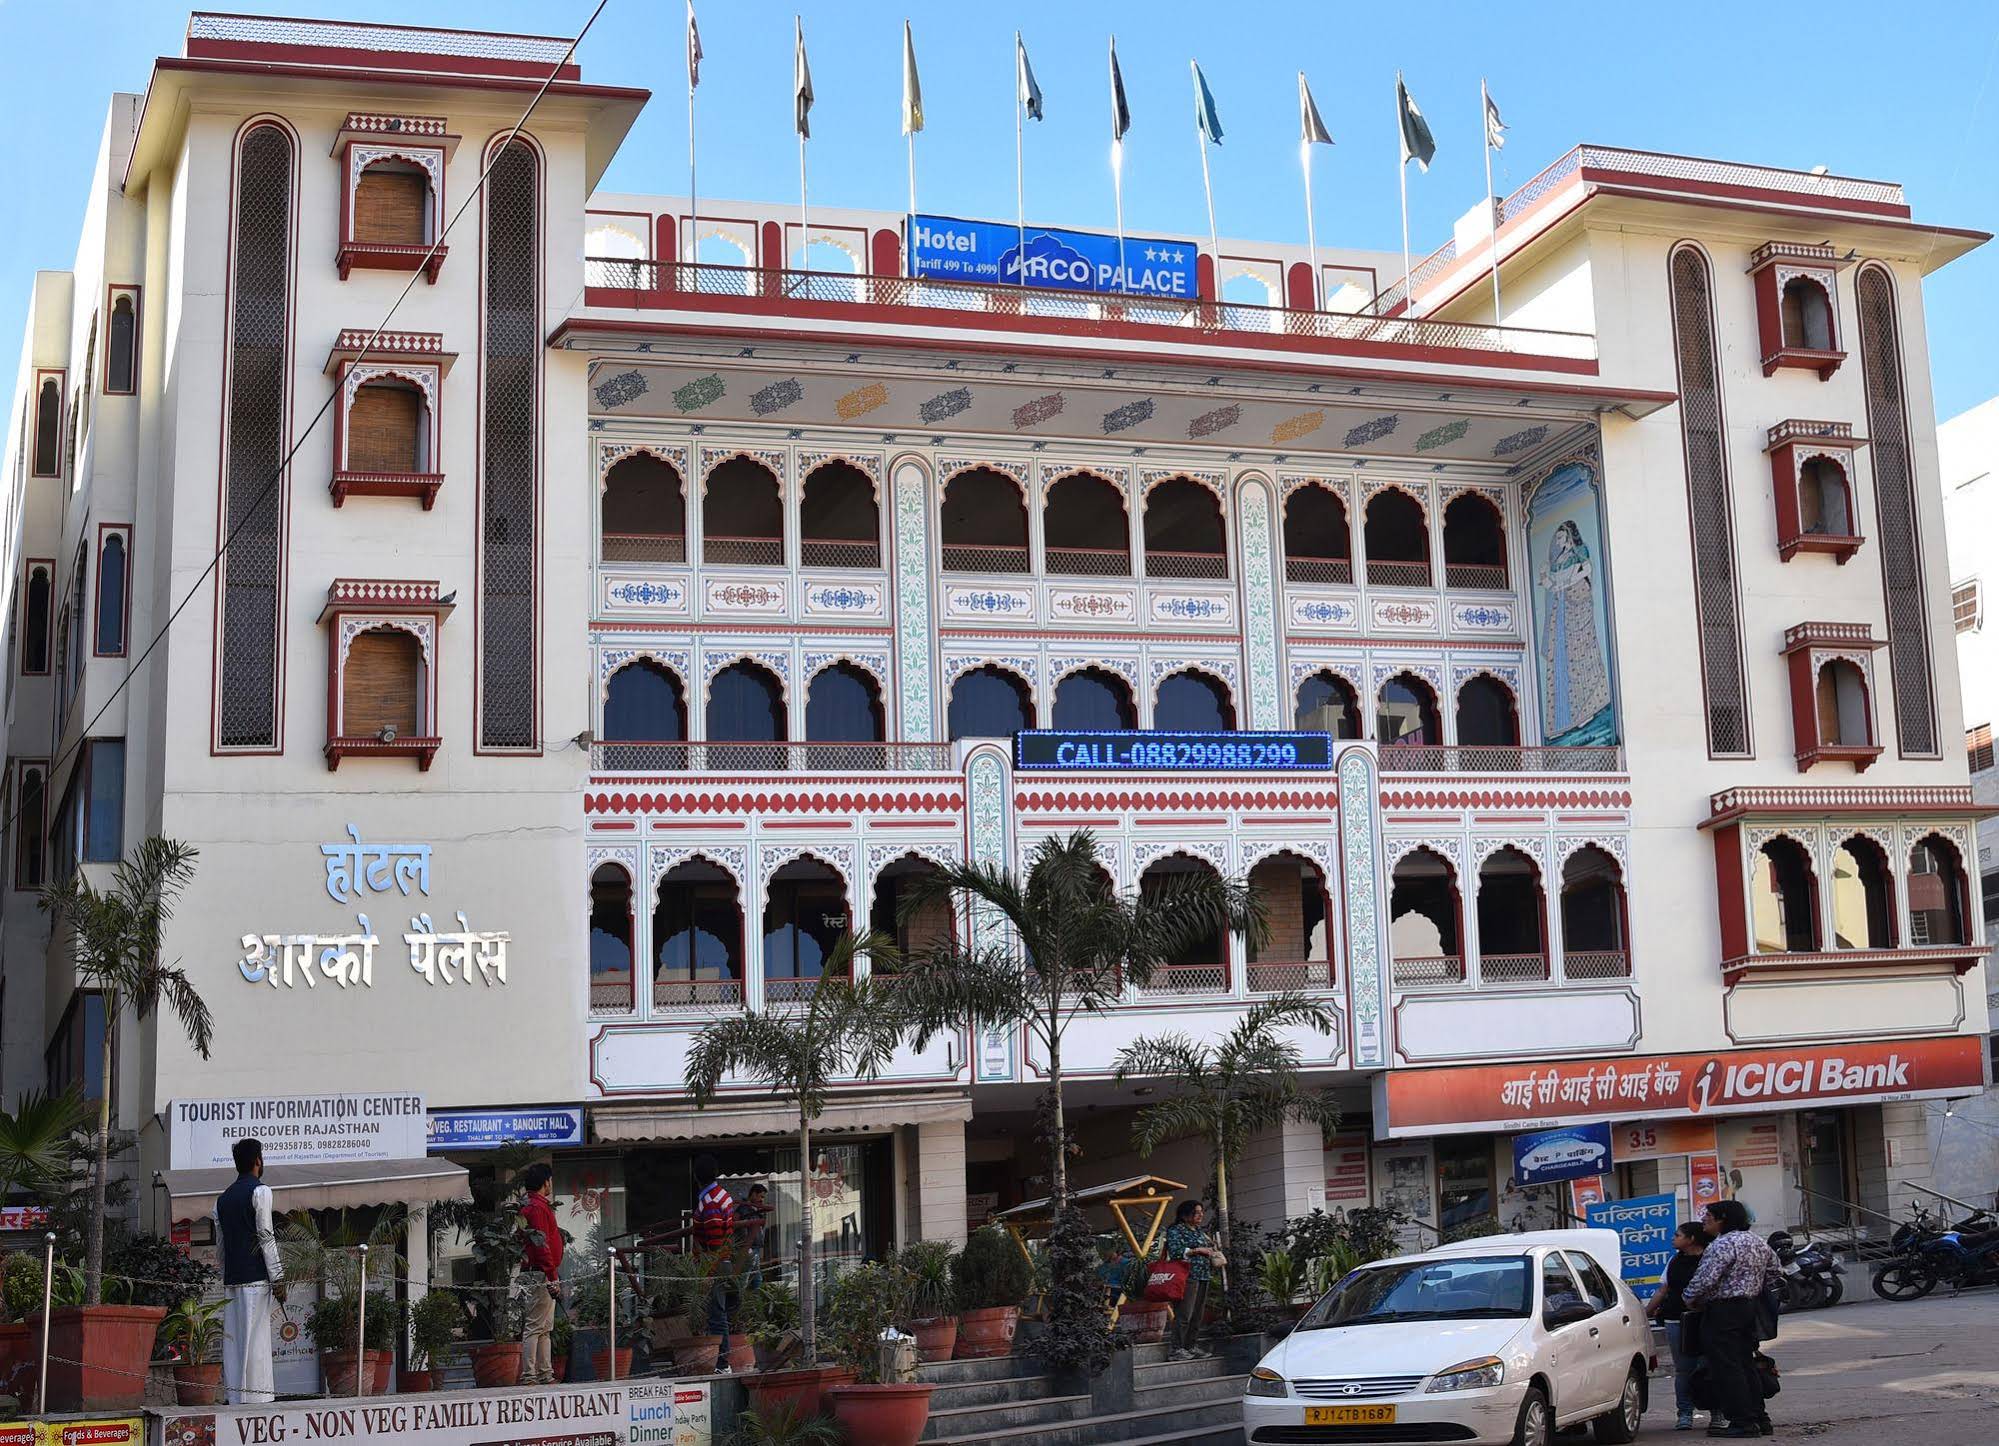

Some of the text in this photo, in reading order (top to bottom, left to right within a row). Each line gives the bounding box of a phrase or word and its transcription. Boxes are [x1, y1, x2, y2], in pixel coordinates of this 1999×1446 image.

[915, 225, 976, 252] Hotel
[916, 256, 997, 276] Tariff 499 To 4999
[1007, 255, 1186, 294] ARCO PALACE
[320, 823, 433, 904] होटल
[239, 910, 512, 989] आरको पैलेस
[1501, 1061, 1682, 1110] आई सी आई सी आई बैंक
[1724, 1060, 1814, 1098] ICICI
[1818, 1055, 1910, 1091] Bank
[179, 1096, 422, 1122] TOURIST INFORMATION CENTER
[222, 1122, 380, 1138] REDISCOVER RAJASTHAN
[453, 1119, 503, 1132] RESTAURANT
[512, 1117, 549, 1131] BANQUET
[549, 1117, 569, 1129] HALL
[629, 1384, 673, 1398] BREAK FAST
[235, 1415, 286, 1445] VEG
[305, 1409, 356, 1439] NON
[362, 1406, 408, 1434] VEG
[413, 1400, 492, 1430] FAMILY
[496, 1392, 621, 1424] RESTAURANT
[630, 1402, 671, 1421] Lunch
[0, 1433, 35, 1445] everages
[94, 1429, 129, 1440] Beverages
[630, 1425, 673, 1443] Dinner
